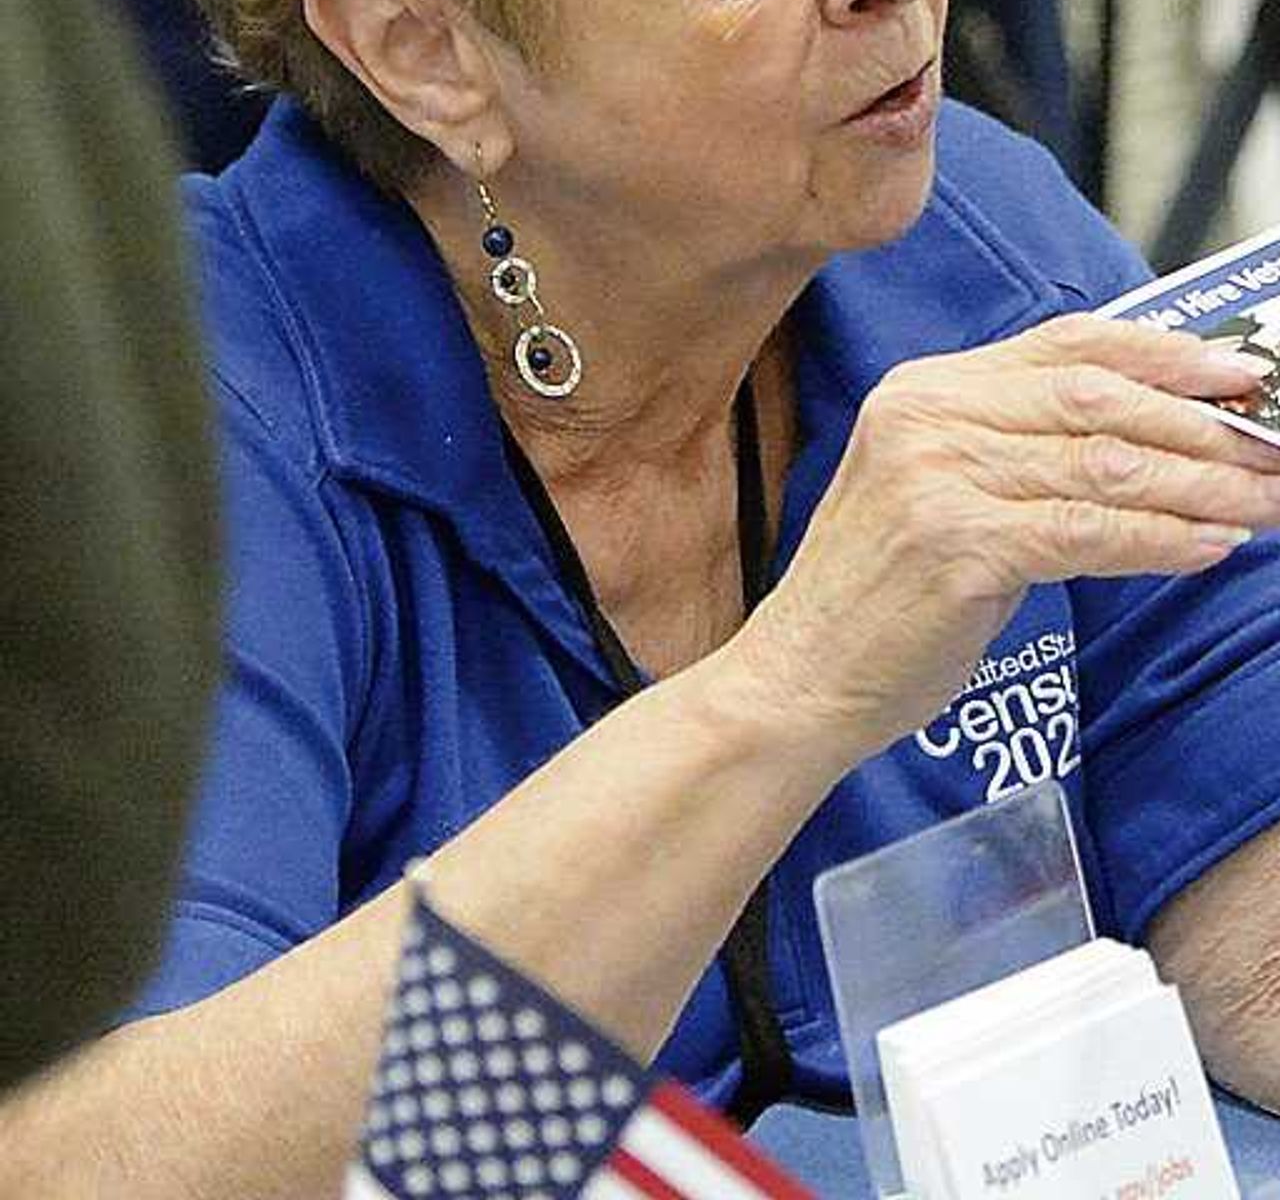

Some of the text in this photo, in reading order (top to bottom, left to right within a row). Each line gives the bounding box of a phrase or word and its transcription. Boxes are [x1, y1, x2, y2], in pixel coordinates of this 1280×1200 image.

[1174, 283, 1243, 319] Hire
[972, 711, 1083, 804] 202
[982, 1075, 1182, 1188] Apply Online Today!
